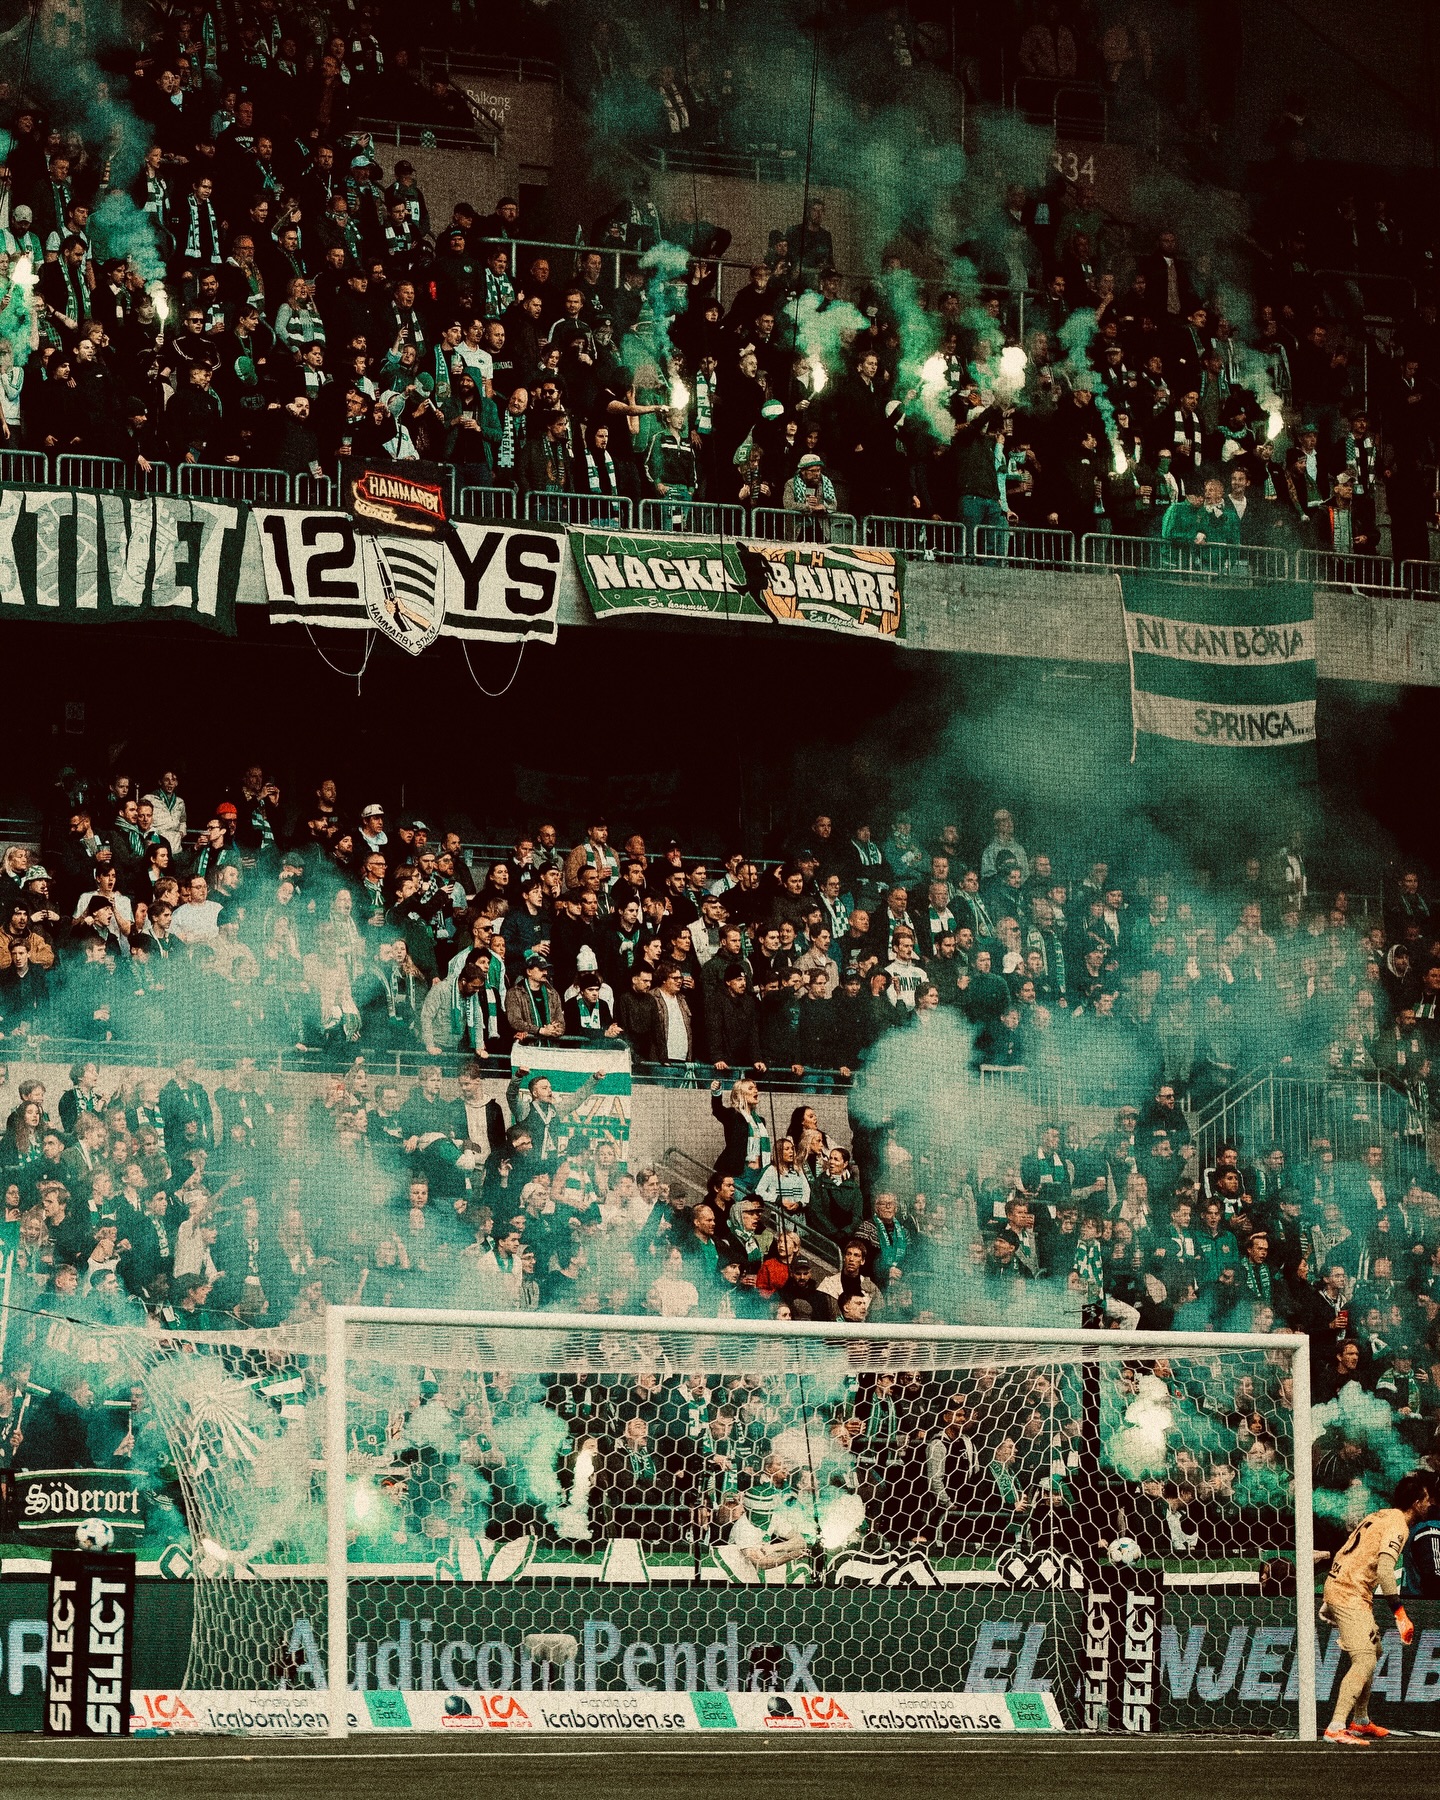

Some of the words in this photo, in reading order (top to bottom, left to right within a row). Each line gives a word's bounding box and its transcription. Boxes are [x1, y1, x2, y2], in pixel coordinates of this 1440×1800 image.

[466, 89, 511, 110] Balkong
[369, 475, 439, 513] HAMMARBY
[586, 552, 739, 595] NACKA
[369, 603, 414, 649] HAMMARBY
[1135, 617, 1168, 650] NI
[1174, 625, 1230, 657] KAN
[1233, 628, 1304, 659] BÖRJA
[24, 1481, 141, 1516] Söderort
[49, 1575, 77, 1732] SELECT
[86, 1576, 126, 1734] SELECT
[277, 1617, 820, 1690] AudicomPendx
[1083, 1588, 1111, 1731] SELECT
[1122, 1590, 1155, 1732] SELECT
[143, 1695, 195, 1719] ICA
[208, 1708, 358, 1728] icabombene
[480, 1695, 528, 1719] ICA
[541, 1709, 686, 1728] icabomben.se
[801, 1696, 850, 1720] ICA
[861, 1710, 1001, 1728] icabomben.se
[1014, 1701, 1037, 1710] Uber
[1017, 1711, 1042, 1721] Eats
